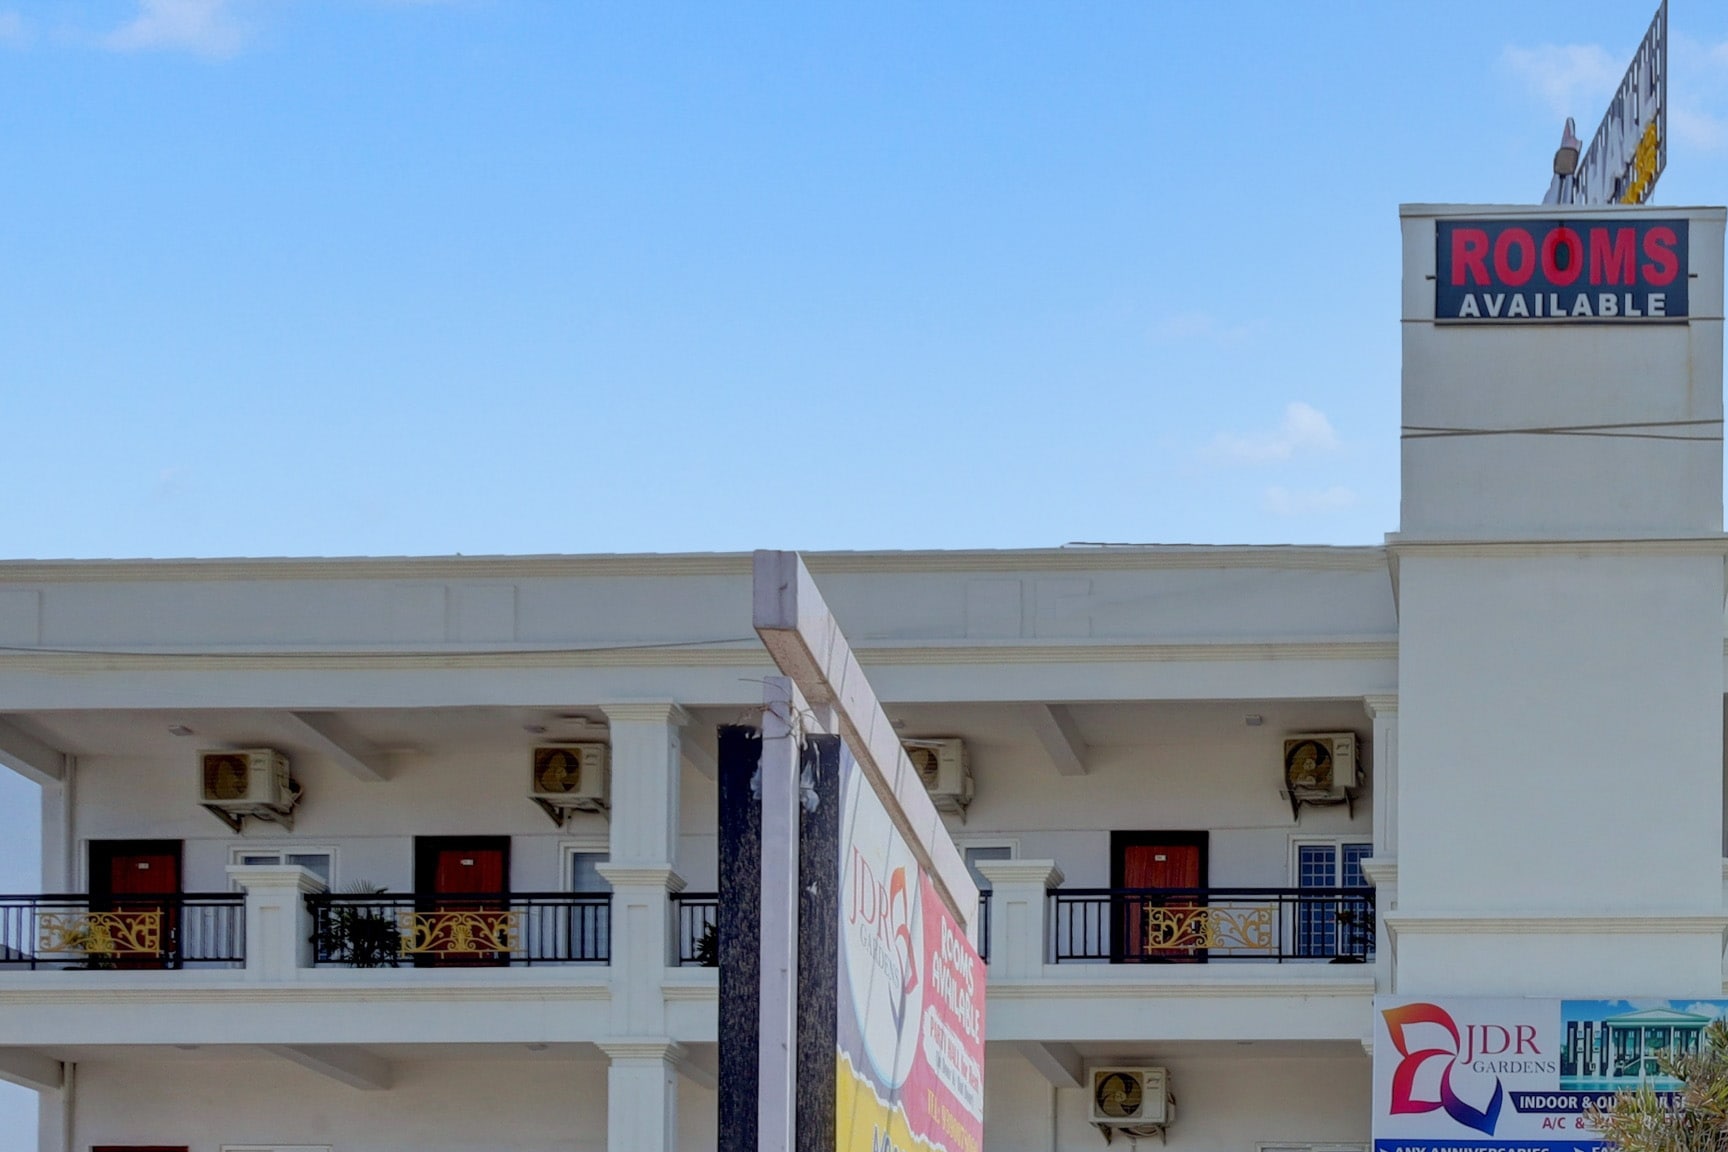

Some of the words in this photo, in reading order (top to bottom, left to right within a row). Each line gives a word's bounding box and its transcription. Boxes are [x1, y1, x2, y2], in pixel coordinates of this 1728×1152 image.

[1450, 227, 1680, 287] ROOMS
[1458, 293, 1666, 318] AVAILABLE
[850, 844, 892, 952] JDR
[860, 923, 900, 989] GARDENS
[941, 915, 974, 997] ROOMS
[932, 952, 980, 1045] AVAILABLE
[1461, 1025, 1541, 1065] JDR
[1473, 1061, 1556, 1074] GARDENS
[1520, 1096, 1578, 1109] INDOOR
[1582, 1096, 1592, 1109] &
[1542, 1117, 1566, 1130] A/C
[1575, 1118, 1585, 1129] &
